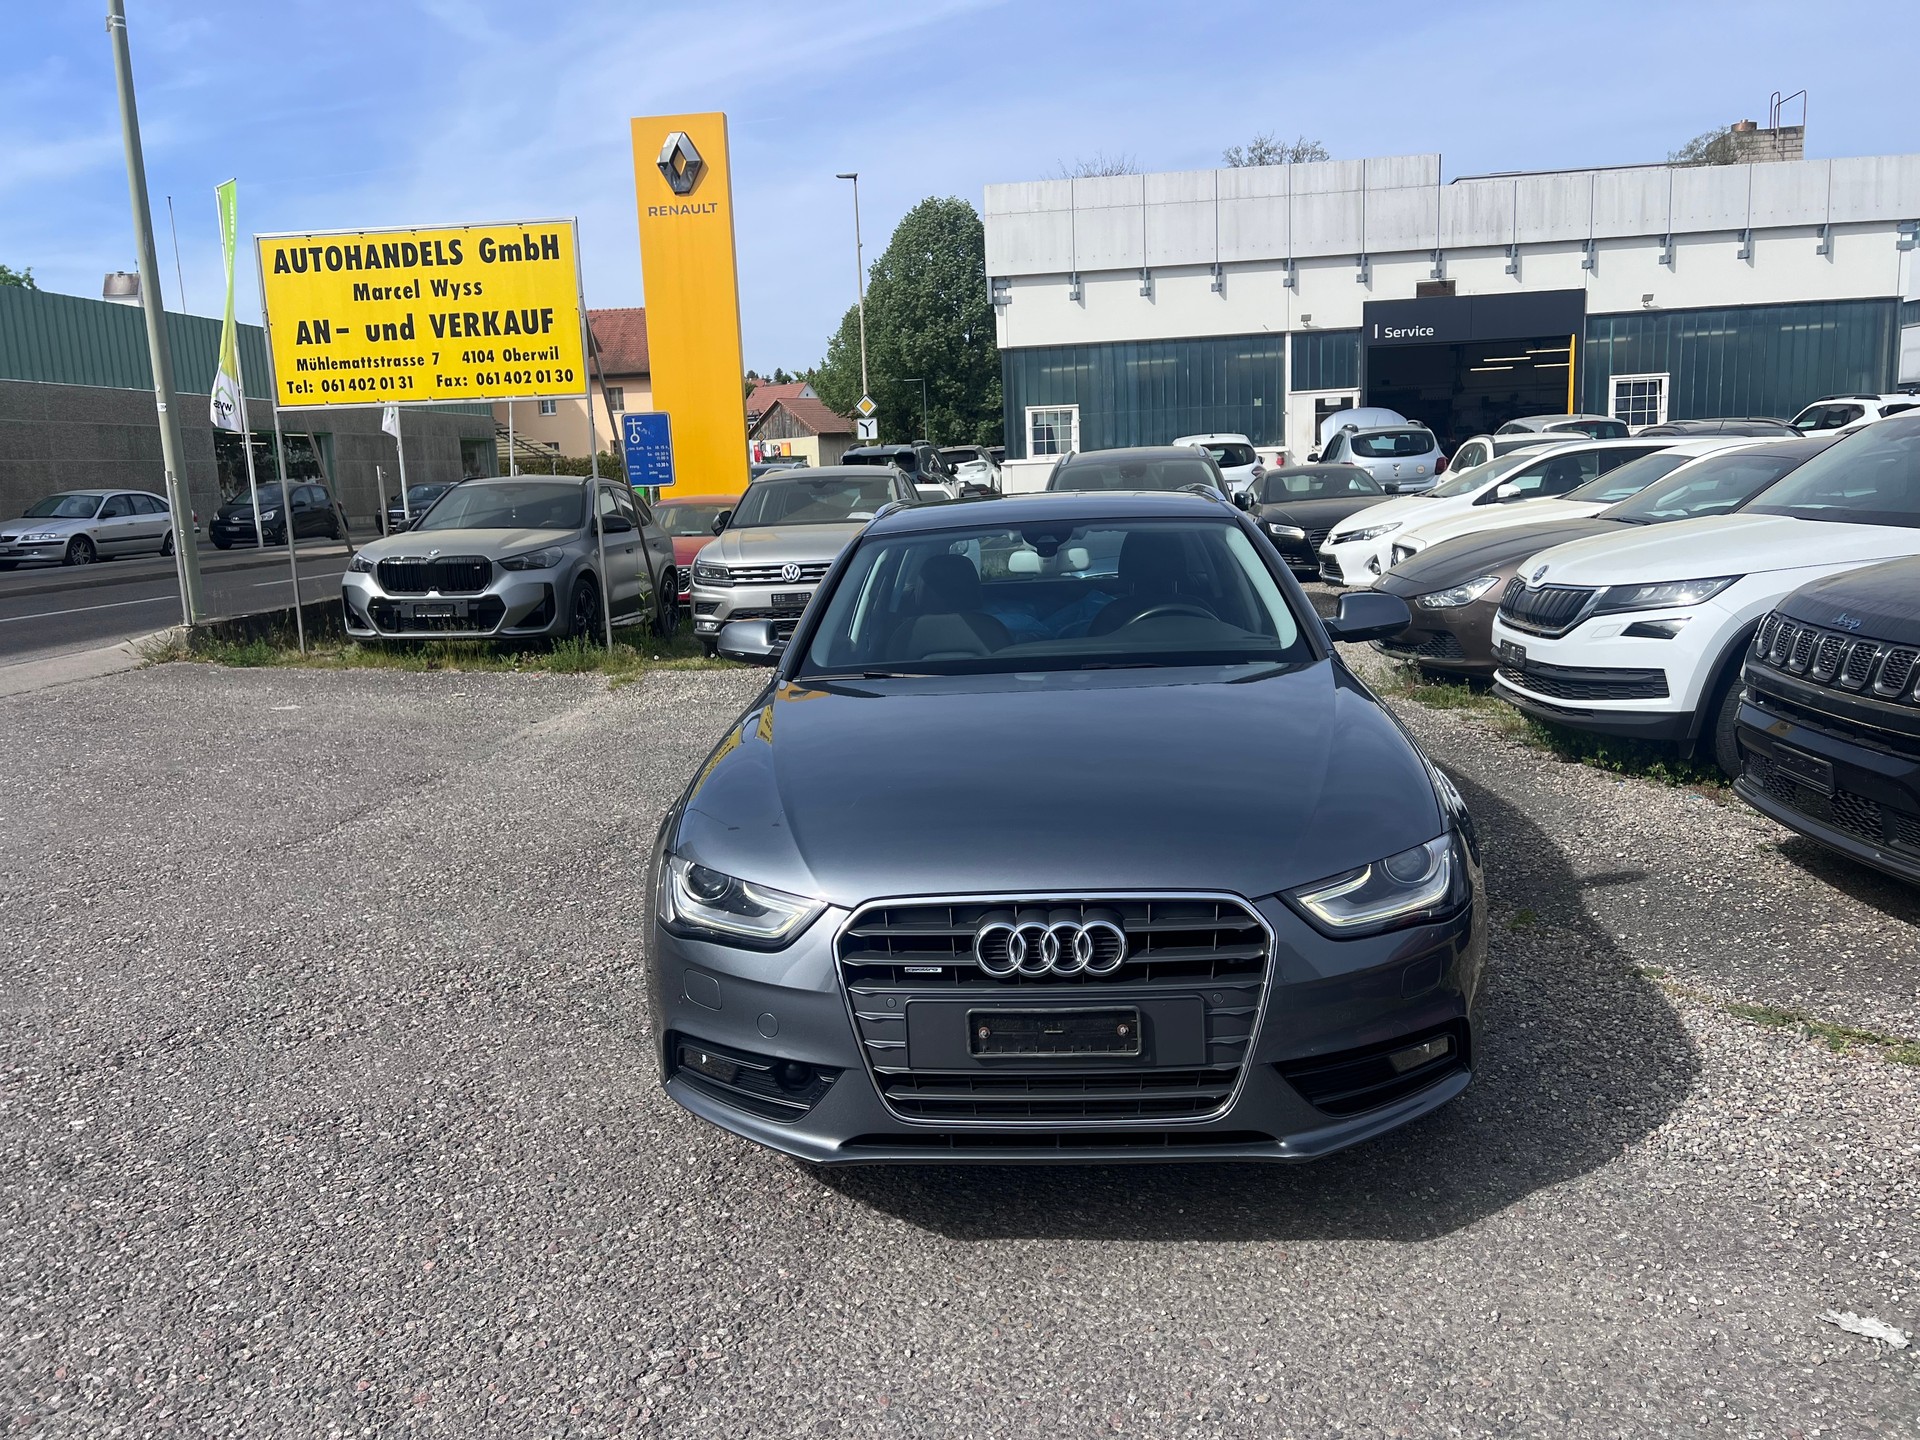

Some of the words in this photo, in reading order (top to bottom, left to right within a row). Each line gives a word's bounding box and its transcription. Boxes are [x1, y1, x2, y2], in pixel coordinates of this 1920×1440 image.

[647, 202, 718, 217] RENAULT
[273, 238, 464, 274] AUTOHANDELS
[478, 233, 560, 264] GmbH
[353, 278, 420, 302] Marcel
[429, 278, 483, 301] Wyss
[365, 313, 415, 342] und
[428, 308, 554, 339] VERKAUF
[1384, 324, 1434, 339] Service
[296, 355, 425, 372] Mühlemattstrasse
[431, 352, 440, 366] 7
[462, 349, 495, 364] 4104
[502, 346, 560, 364] Oberwil
[286, 380, 314, 394] Tel:
[436, 374, 468, 388] Fax:
